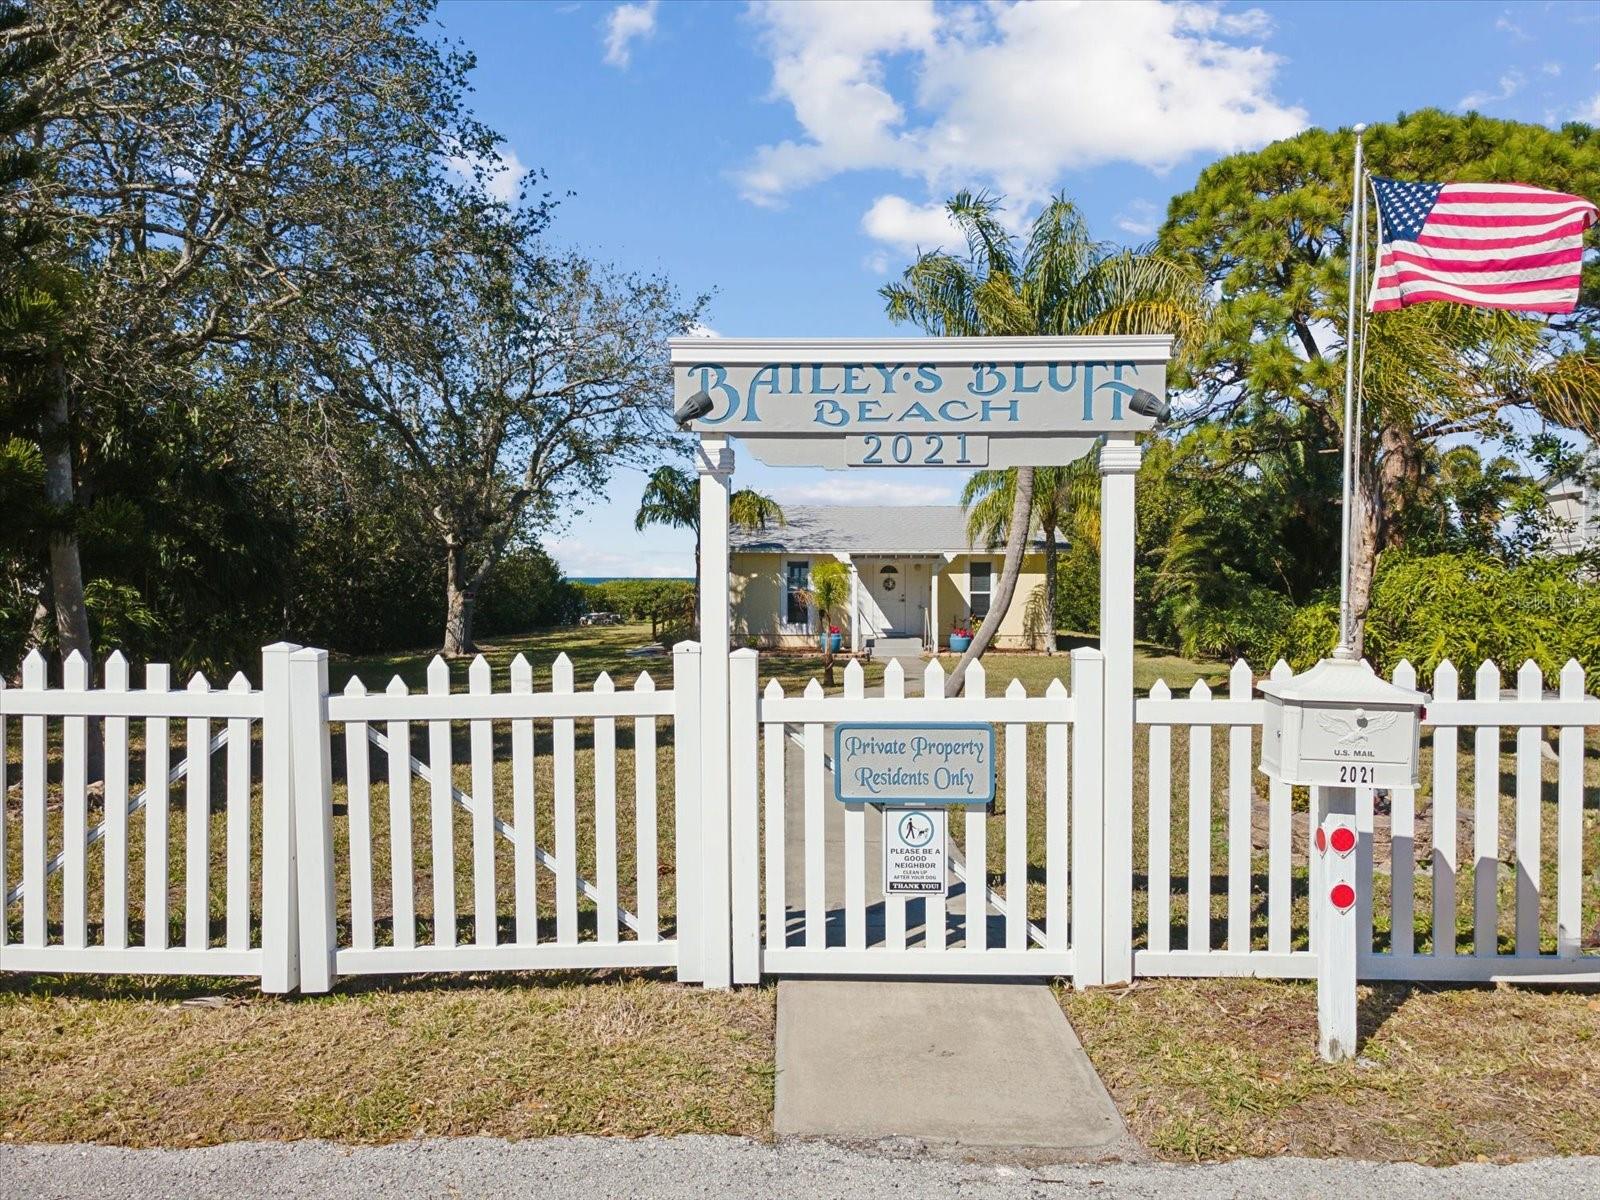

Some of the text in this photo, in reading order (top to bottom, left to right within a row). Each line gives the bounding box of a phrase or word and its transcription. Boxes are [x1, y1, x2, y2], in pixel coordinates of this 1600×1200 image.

[967, 361, 1139, 421] BLUFF
[814, 399, 1020, 427] BEACH
[862, 432, 971, 464] 2021
[845, 736, 985, 764] Private Property
[1334, 749, 1376, 758] U.S. MAIL
[854, 766, 975, 795] Residents Only
[1340, 765, 1374, 784] 2021
